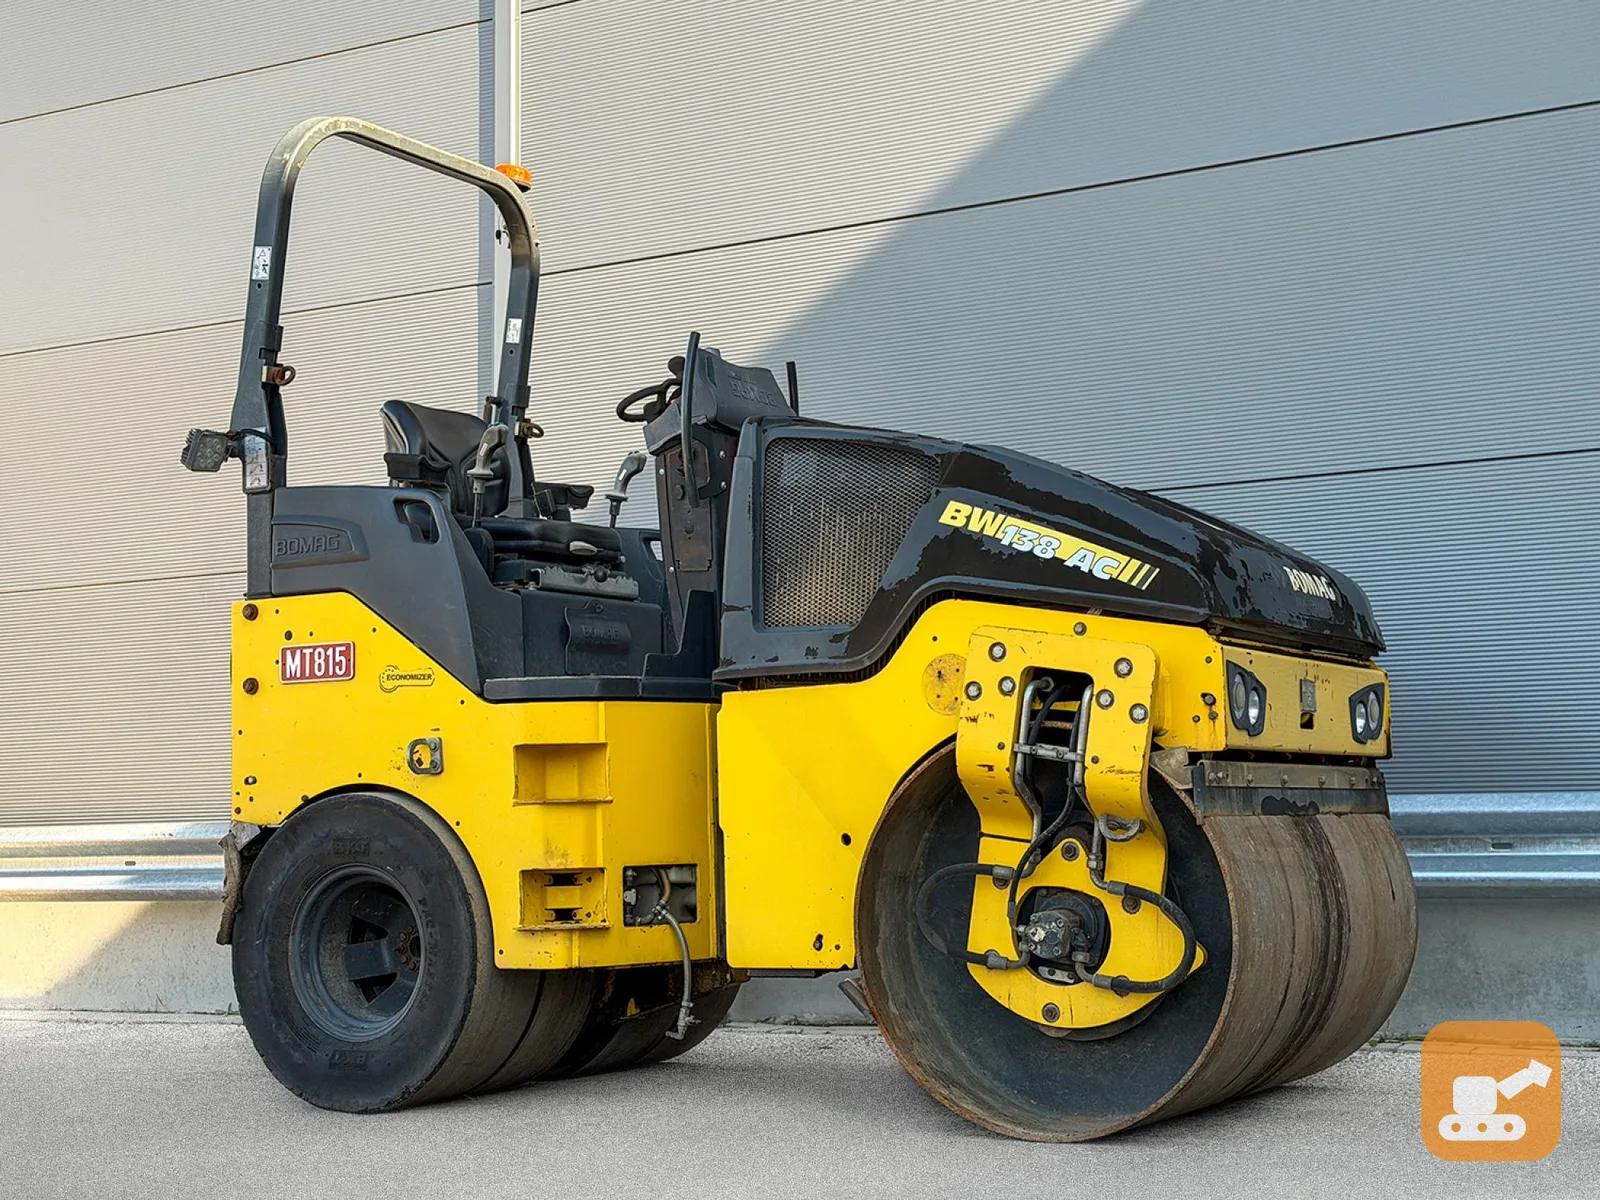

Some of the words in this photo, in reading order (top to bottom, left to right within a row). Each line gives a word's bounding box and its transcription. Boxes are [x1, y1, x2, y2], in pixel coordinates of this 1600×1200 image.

[276, 534, 341, 556] BOMAG
[1064, 547, 1121, 581] AC
[284, 646, 347, 679] MT815
[386, 673, 432, 681] ECONOMIZER
